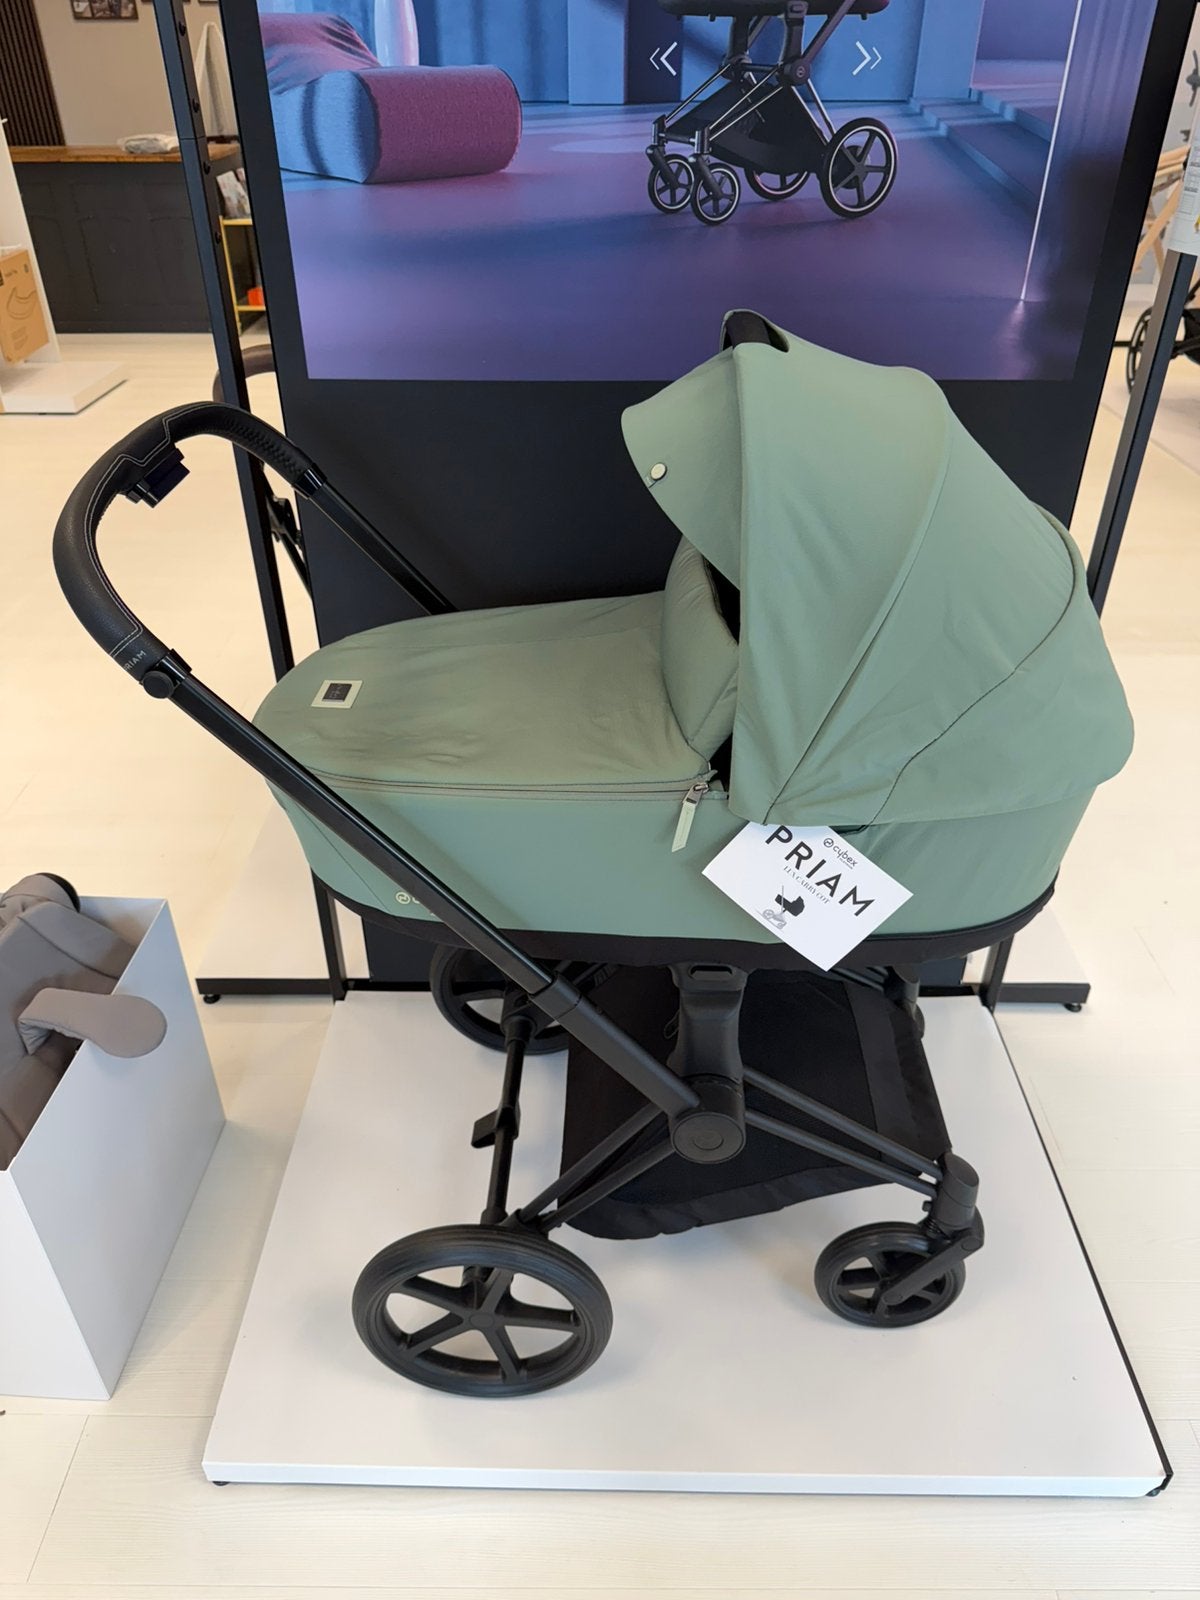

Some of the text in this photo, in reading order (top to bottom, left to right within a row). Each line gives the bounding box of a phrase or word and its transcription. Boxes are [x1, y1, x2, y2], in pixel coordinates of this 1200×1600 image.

[123, 650, 146, 671] RIAM
[832, 845, 858, 868] cybex
[765, 825, 876, 917] PRIAM
